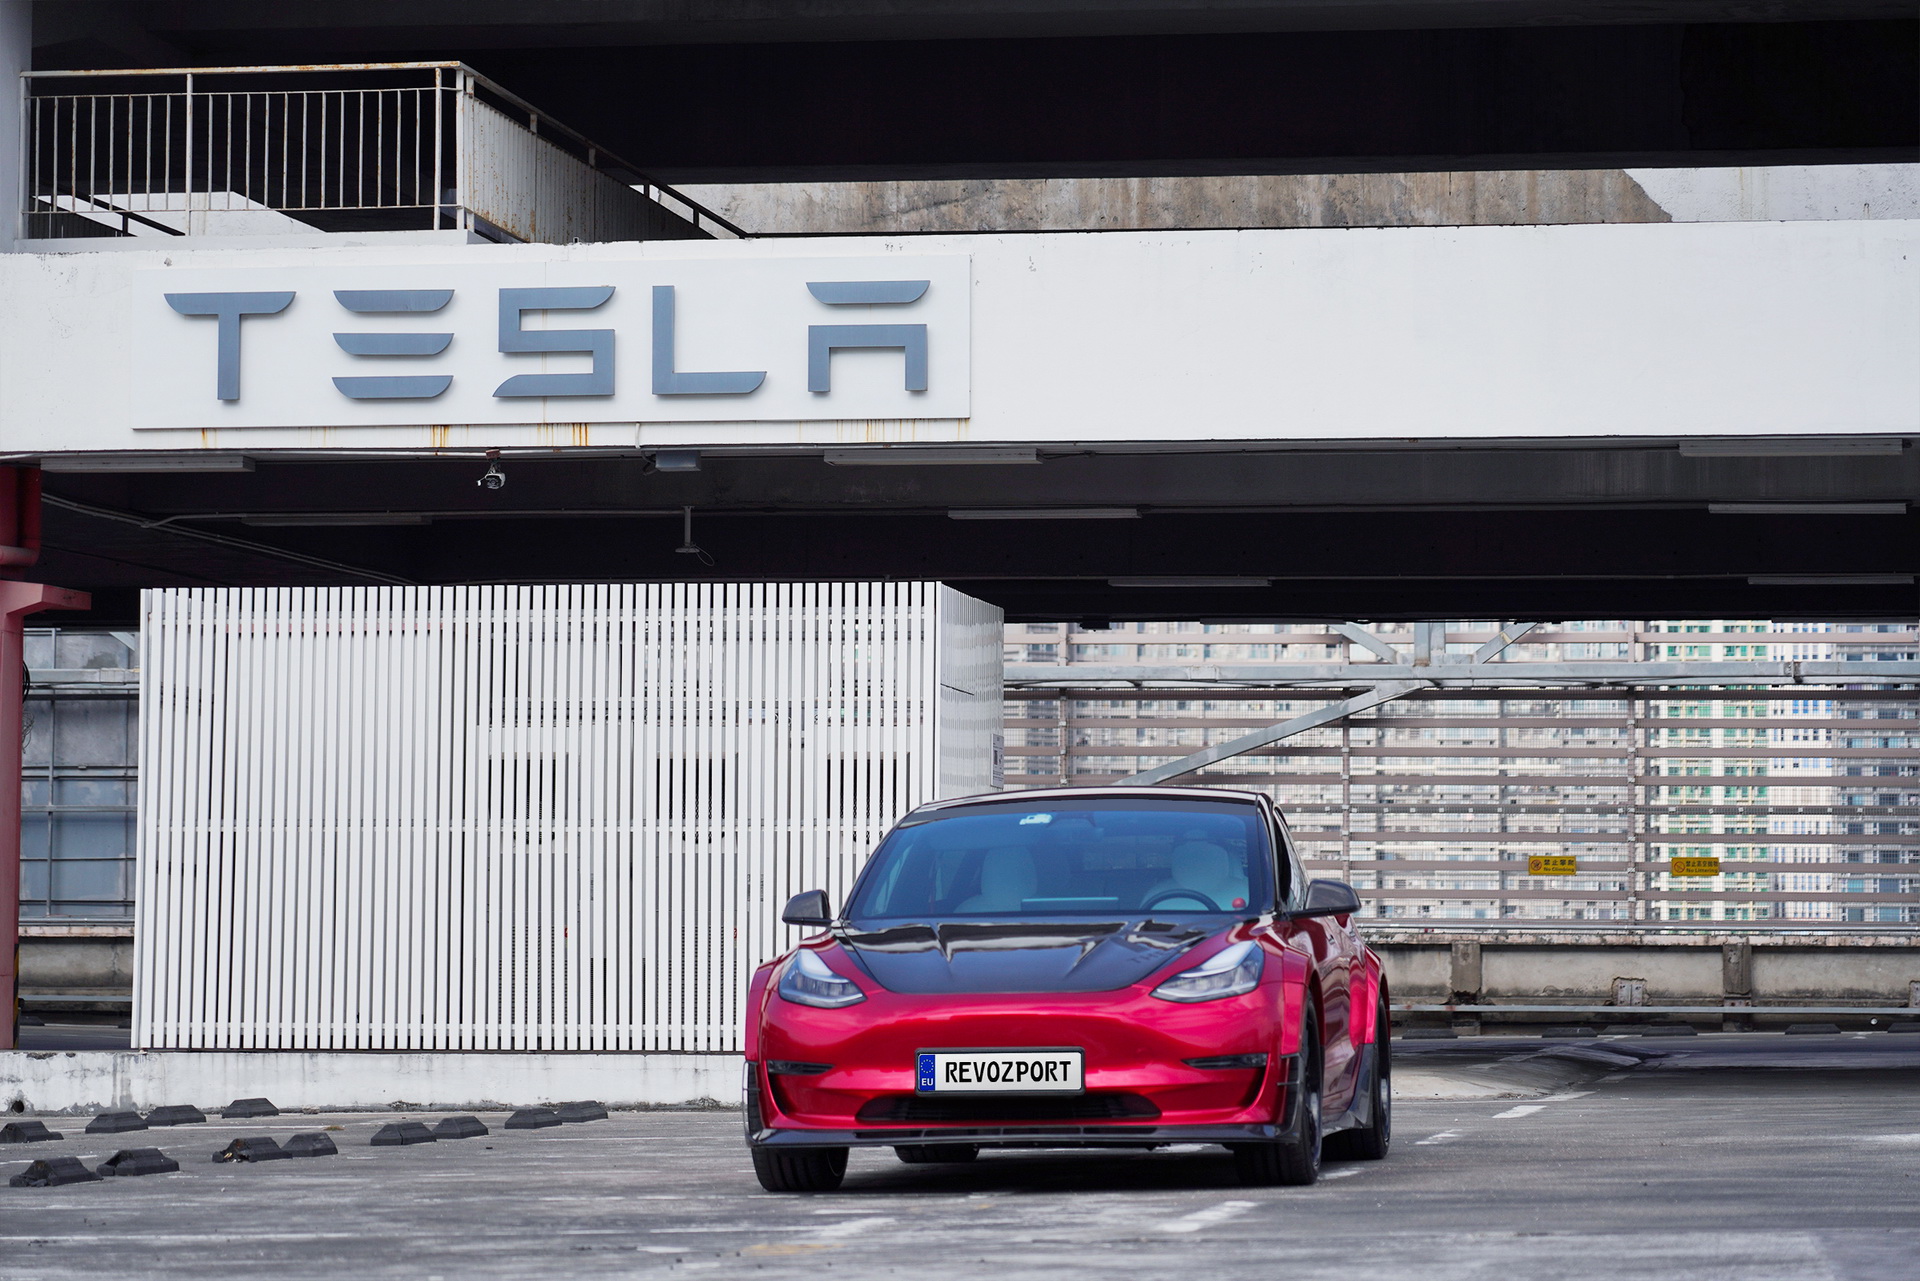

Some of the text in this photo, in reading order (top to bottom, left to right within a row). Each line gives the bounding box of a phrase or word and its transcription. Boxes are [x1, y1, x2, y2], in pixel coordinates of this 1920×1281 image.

[163, 280, 931, 402] TESLA
[921, 1078, 934, 1086] EU
[945, 1061, 1071, 1083] REVOZPORT
